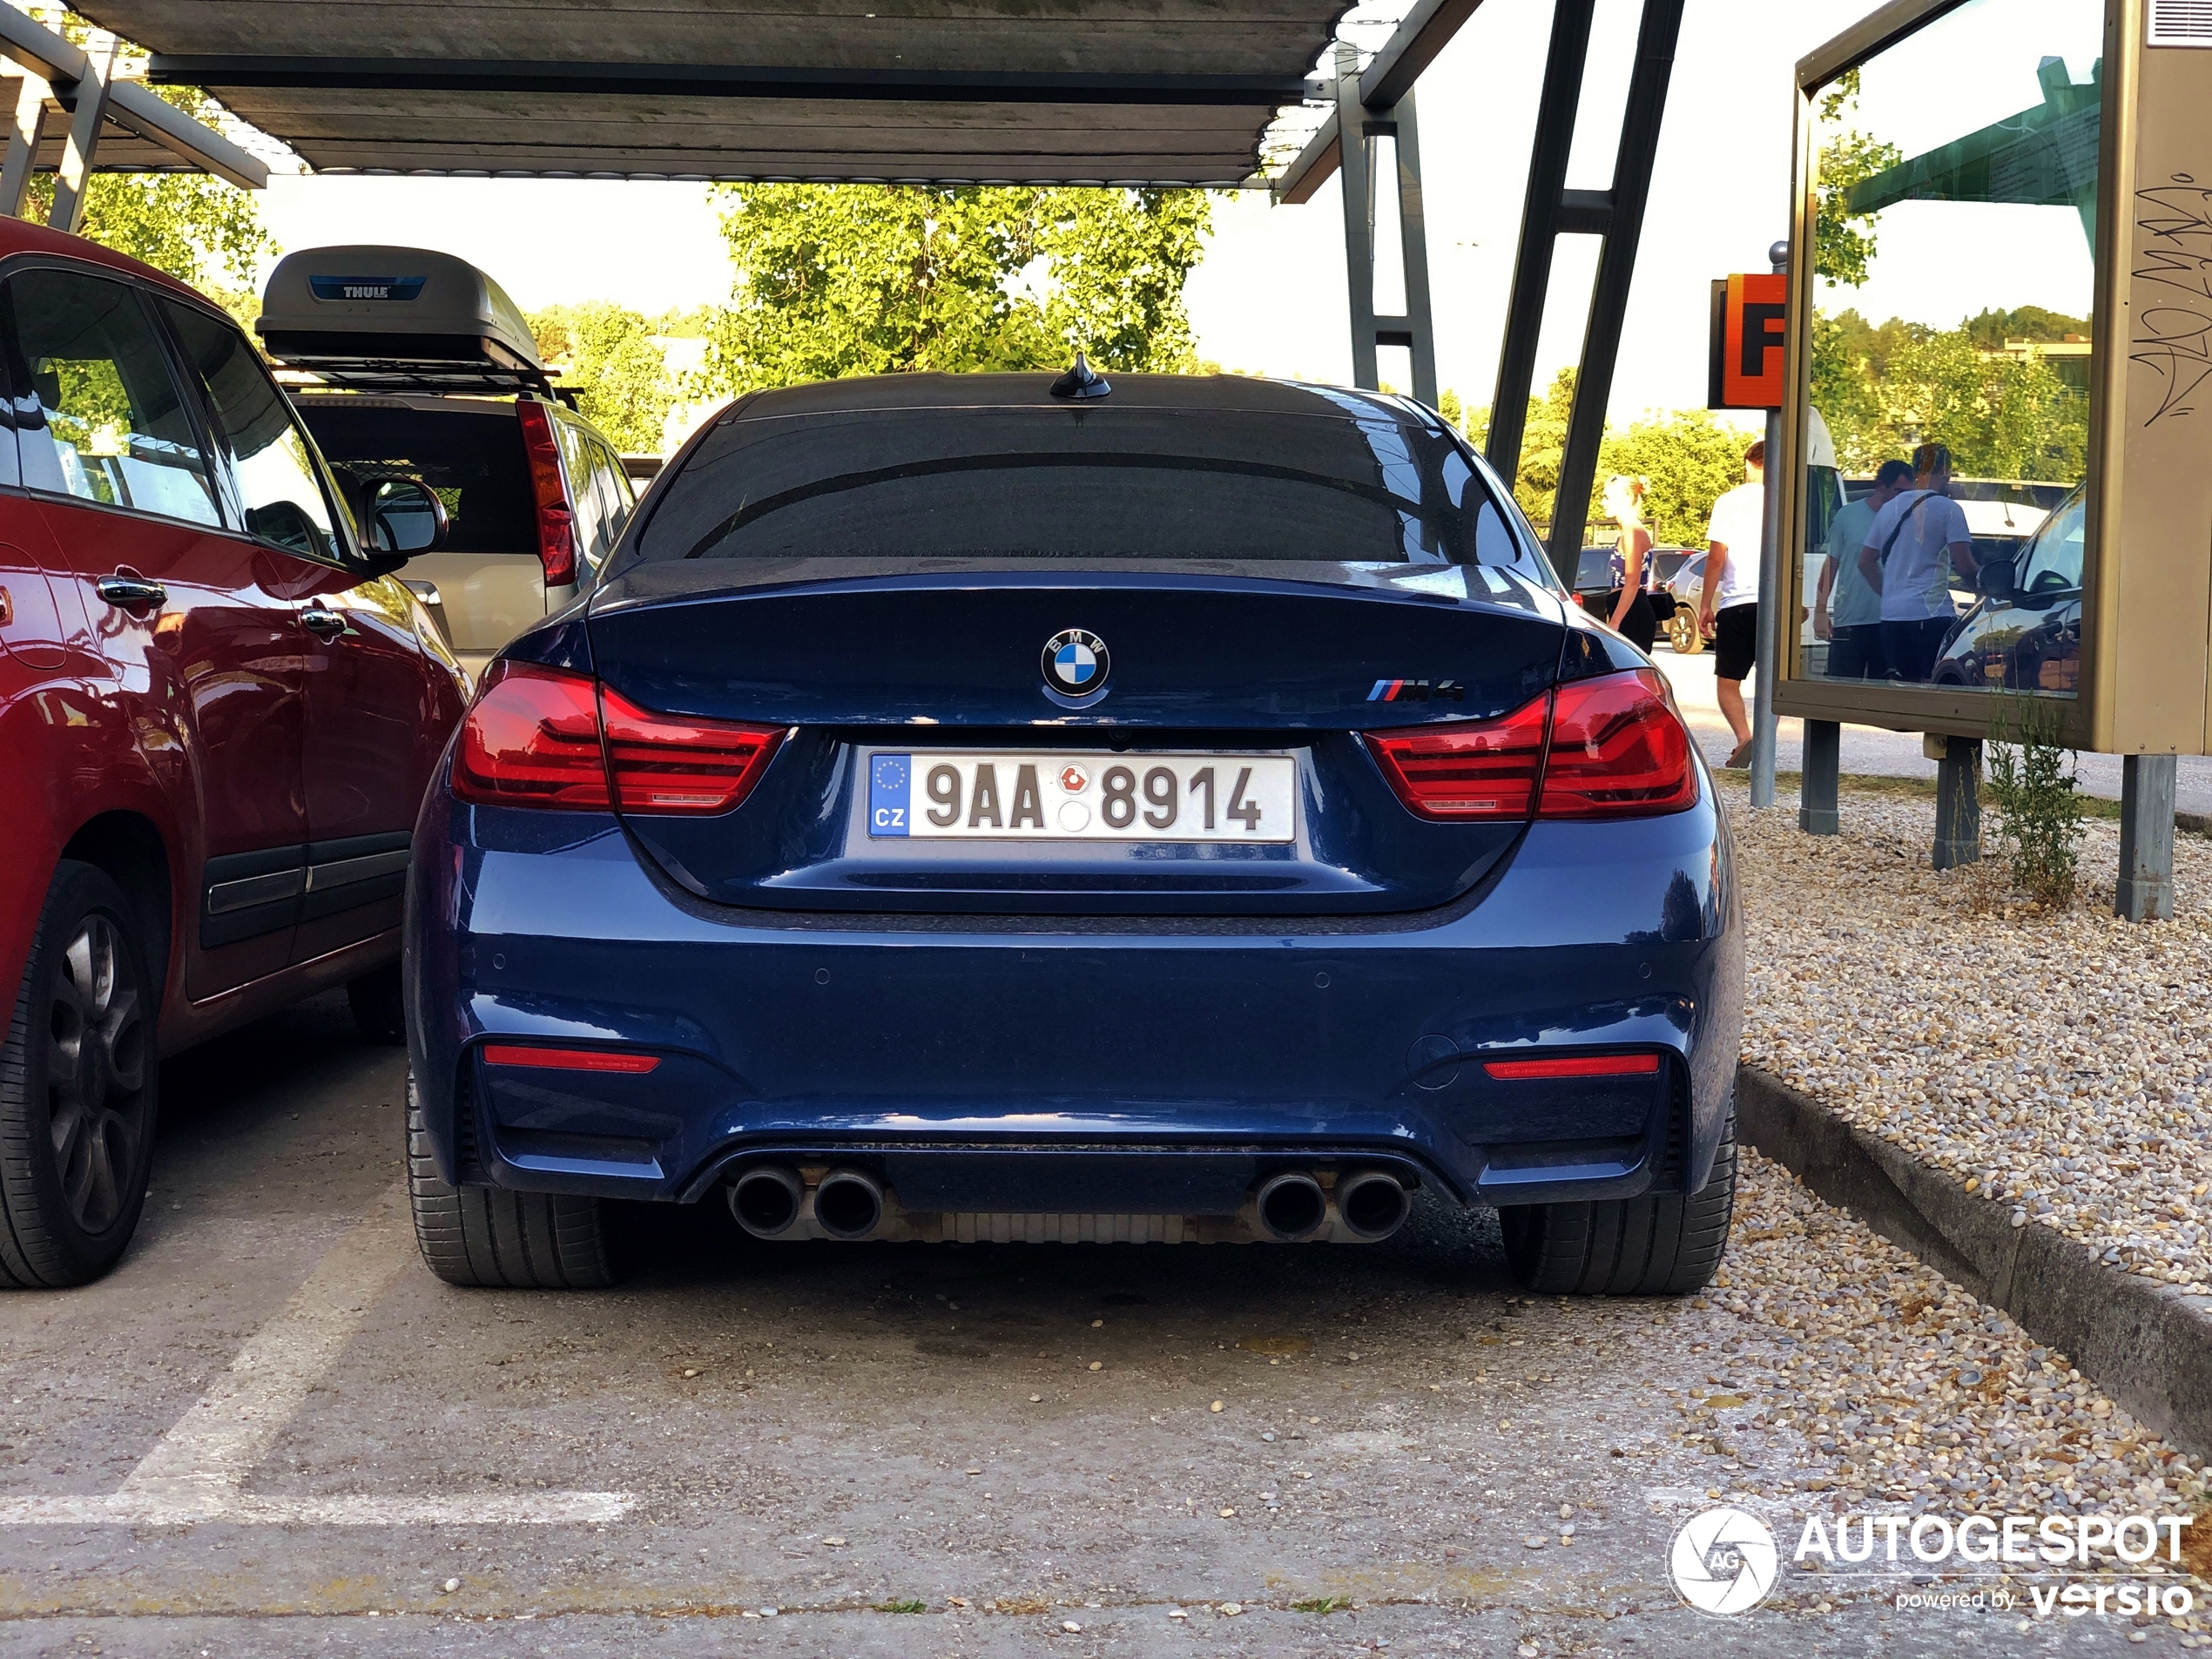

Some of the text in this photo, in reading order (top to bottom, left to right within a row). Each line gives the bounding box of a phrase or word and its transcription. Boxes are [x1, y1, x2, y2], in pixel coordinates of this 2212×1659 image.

[343, 286, 388, 299] THULE
[1048, 631, 1104, 654] BMW
[1394, 679, 1464, 702] M4
[925, 762, 1262, 831] 9AA 8914
[875, 808, 905, 827] CZ
